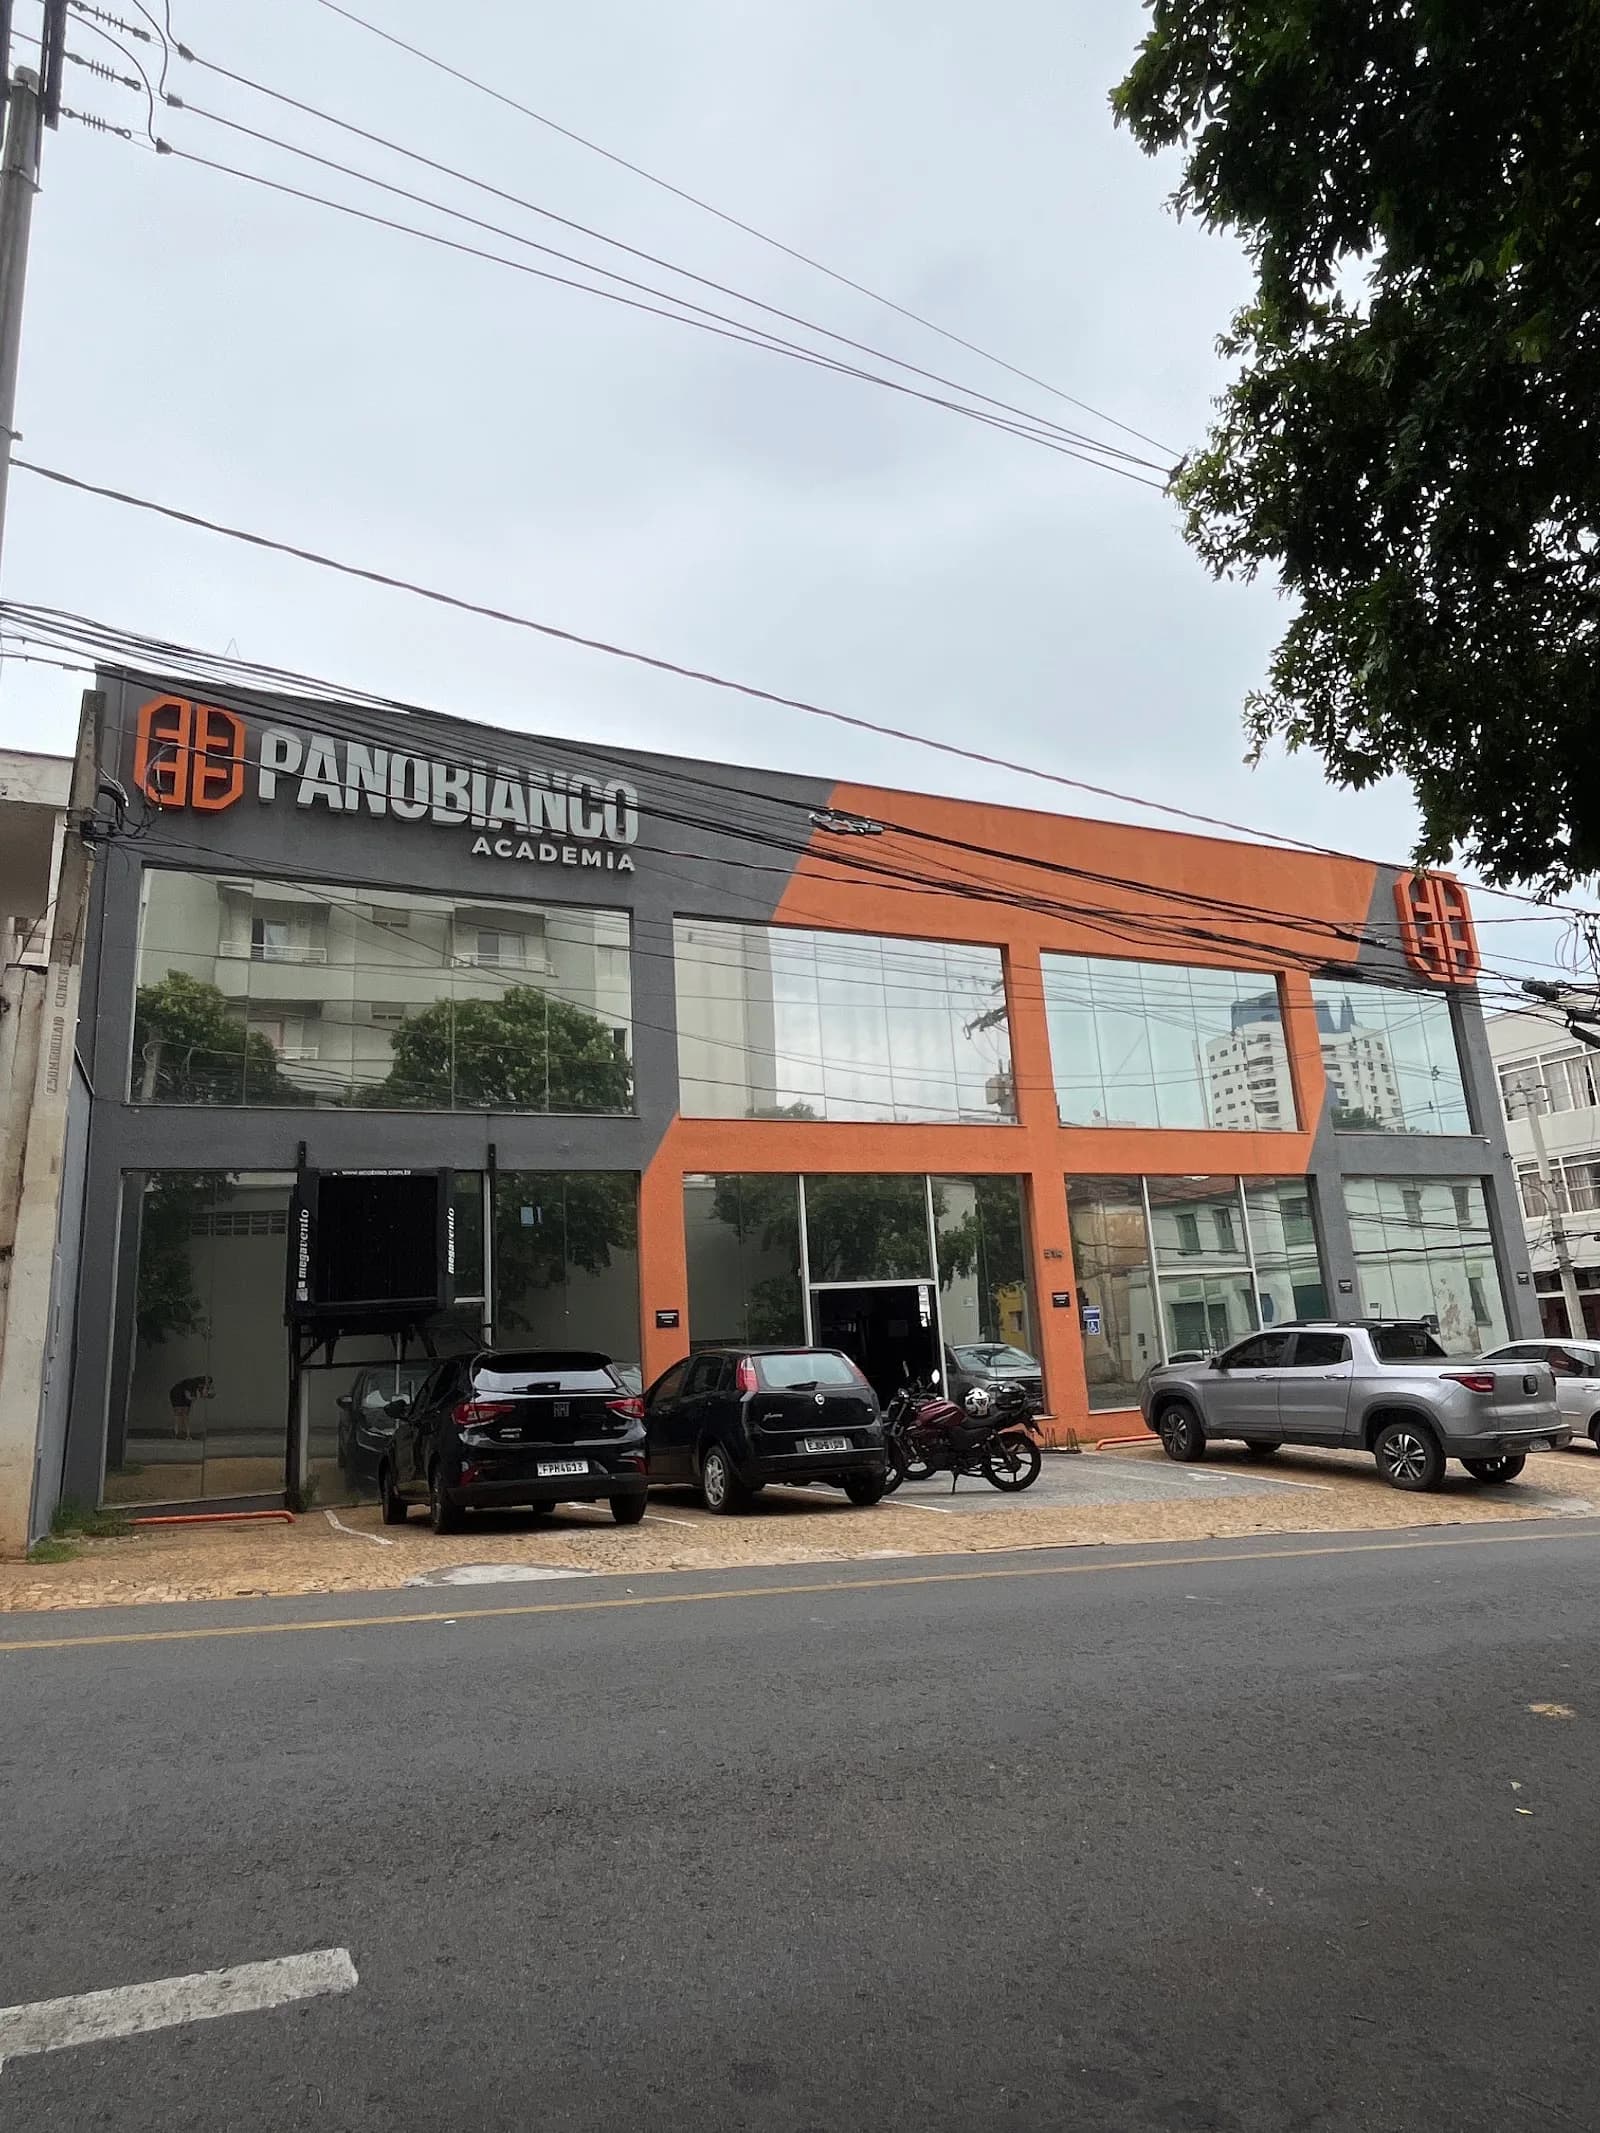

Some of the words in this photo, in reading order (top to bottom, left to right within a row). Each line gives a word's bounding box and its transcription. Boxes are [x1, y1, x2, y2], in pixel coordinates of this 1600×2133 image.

[258, 726, 639, 847] PANOBIANCO
[471, 836, 637, 873] ACADEMIA
[298, 1209, 310, 1278] megavento
